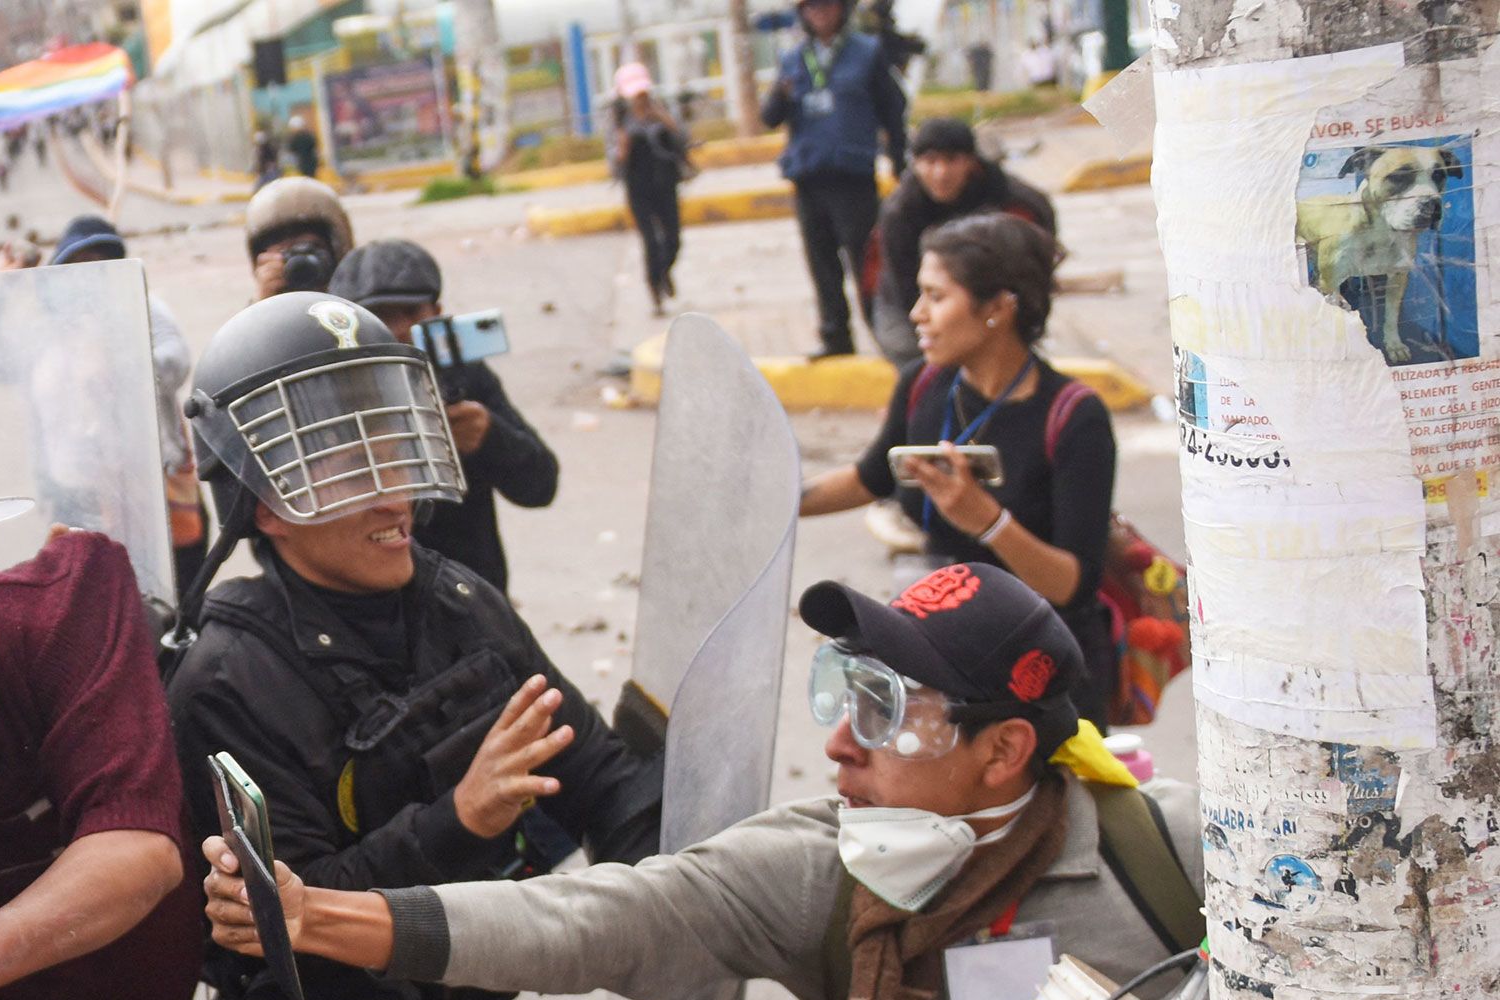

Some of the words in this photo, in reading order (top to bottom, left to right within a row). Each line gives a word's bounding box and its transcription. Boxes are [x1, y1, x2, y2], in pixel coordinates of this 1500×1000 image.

[1243, 397, 1256, 407] LA
[1440, 402, 1467, 415] CASA
[1415, 464, 1432, 475] YA
[1437, 459, 1460, 473] QUE
